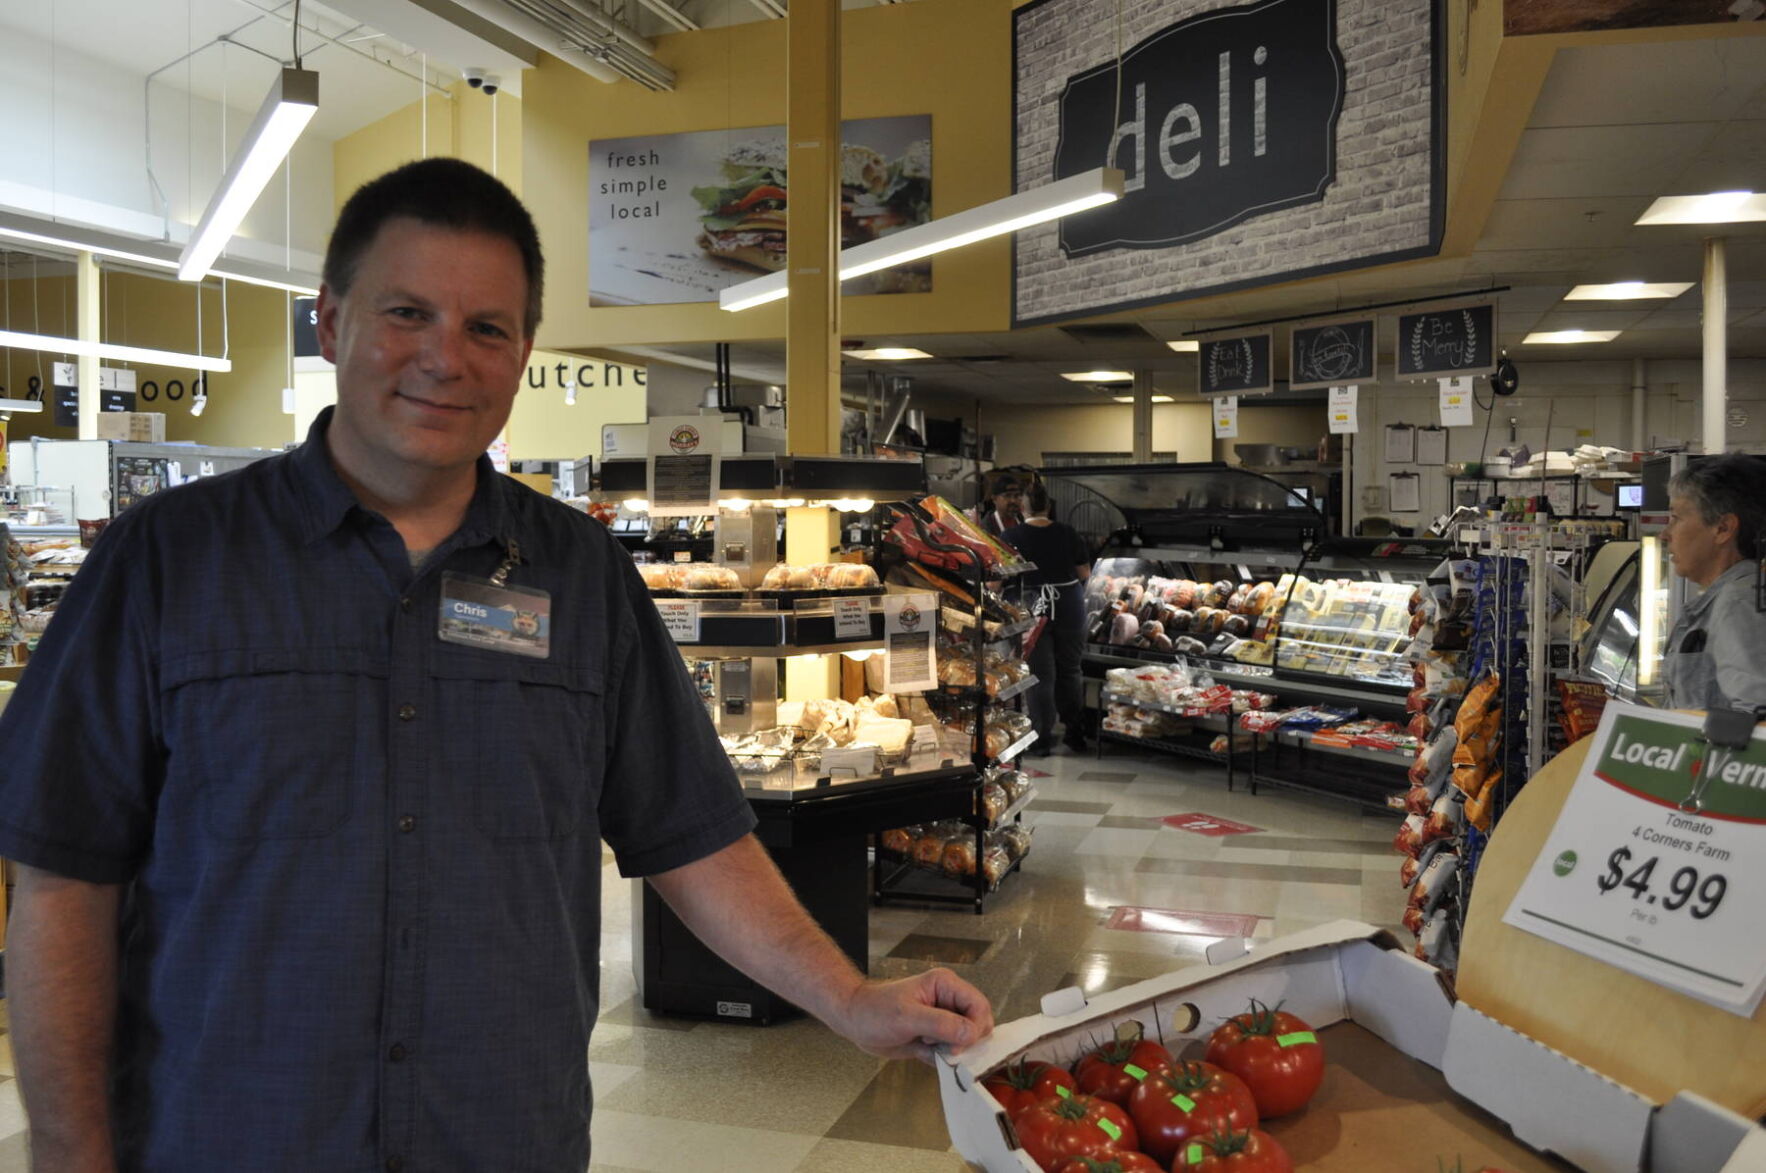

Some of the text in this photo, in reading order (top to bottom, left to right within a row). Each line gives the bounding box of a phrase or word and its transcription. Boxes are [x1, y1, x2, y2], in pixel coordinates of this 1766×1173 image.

[1107, 46, 1267, 192] deli
[608, 149, 660, 168] fresh
[601, 175, 667, 197] simple
[611, 201, 659, 219] local
[1422, 337, 1464, 368] Merry
[453, 602, 488, 618] Chris
[1611, 733, 1687, 771] Local
[1666, 813, 1713, 836] Tomato
[1632, 826, 1731, 861] 4 Corners Farm
[1597, 845, 1728, 920] $4.99
